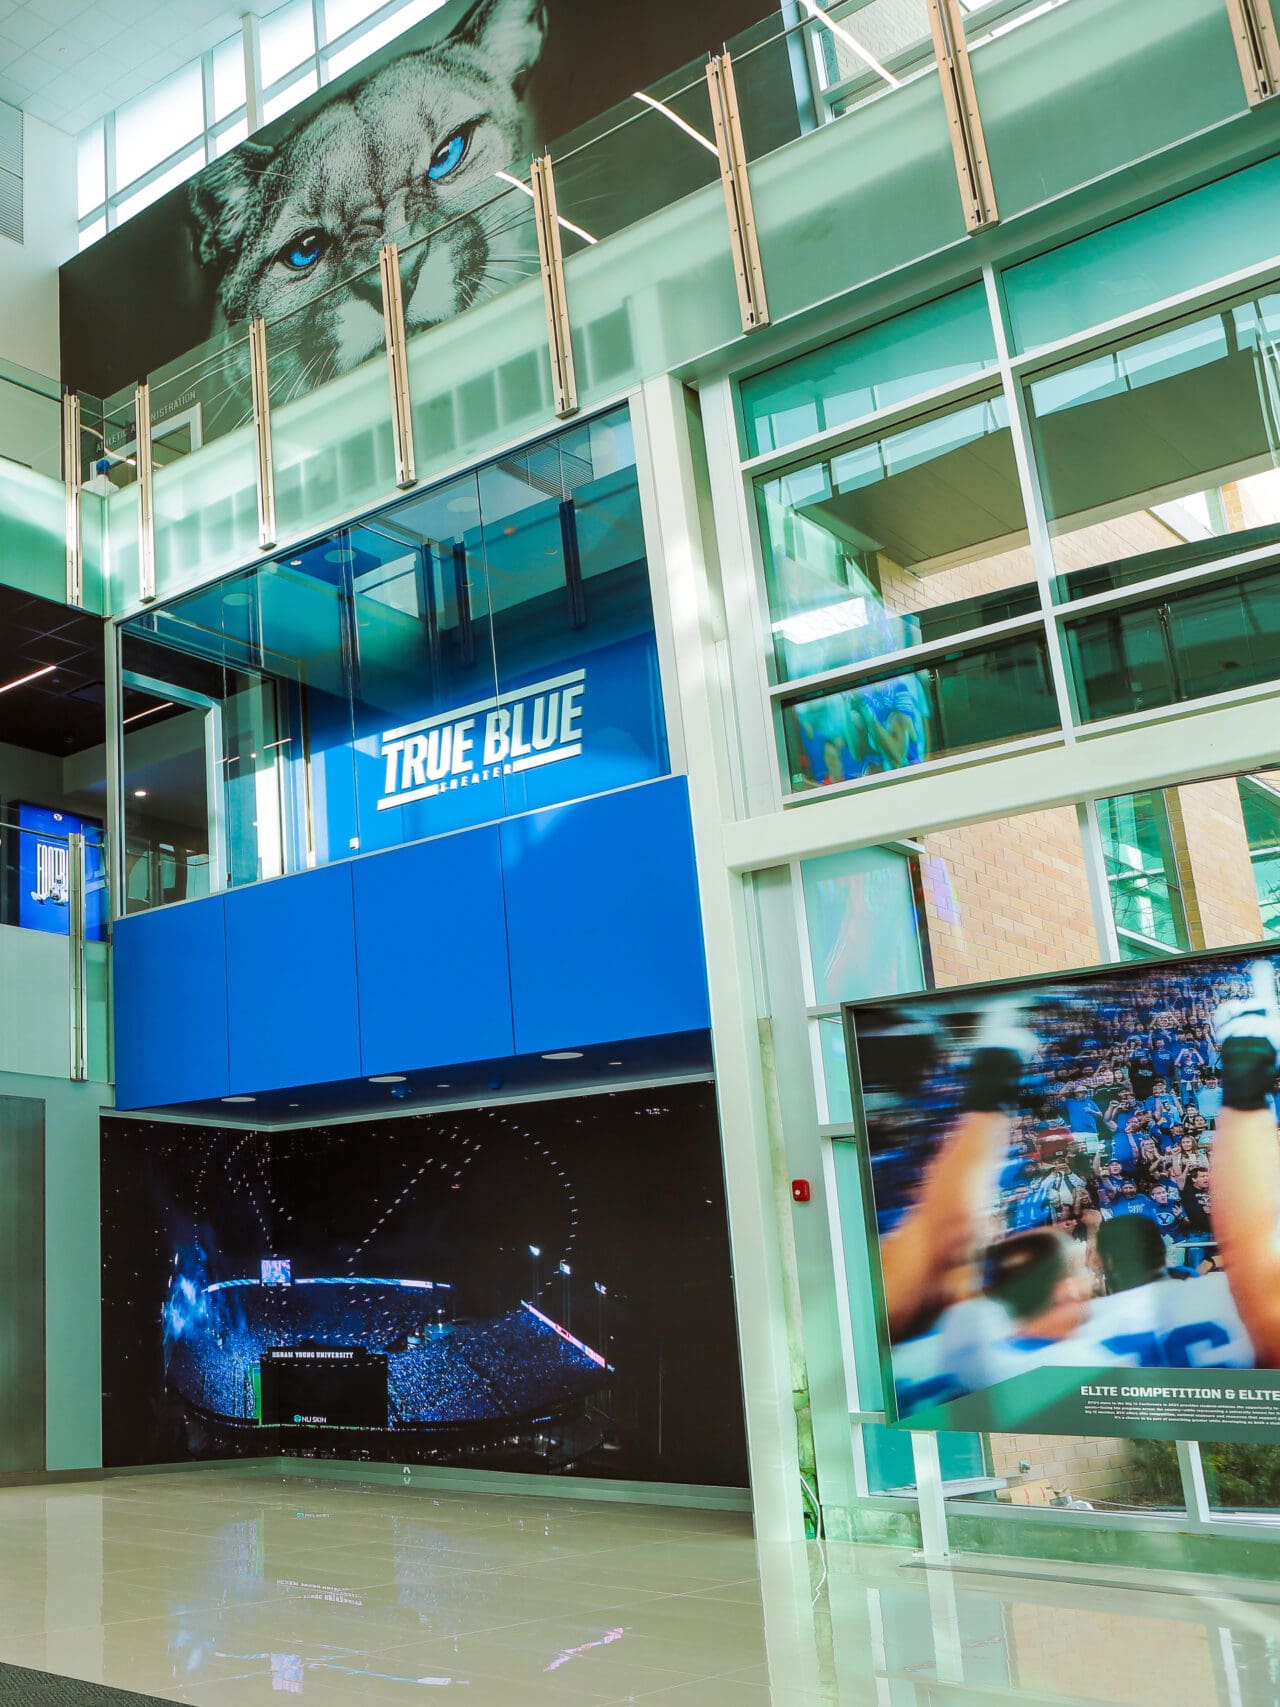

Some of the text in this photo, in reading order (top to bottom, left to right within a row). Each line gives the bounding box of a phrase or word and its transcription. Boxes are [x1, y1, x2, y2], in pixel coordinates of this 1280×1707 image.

[130, 390, 196, 434] ANISTRATION
[381, 684, 585, 795] TRUE BLUE
[437, 762, 513, 793] THEATER
[316, 1352, 354, 1360] UNIVERSITY
[1080, 1385, 1280, 1401] ELITE COMPETITION & ELITE
